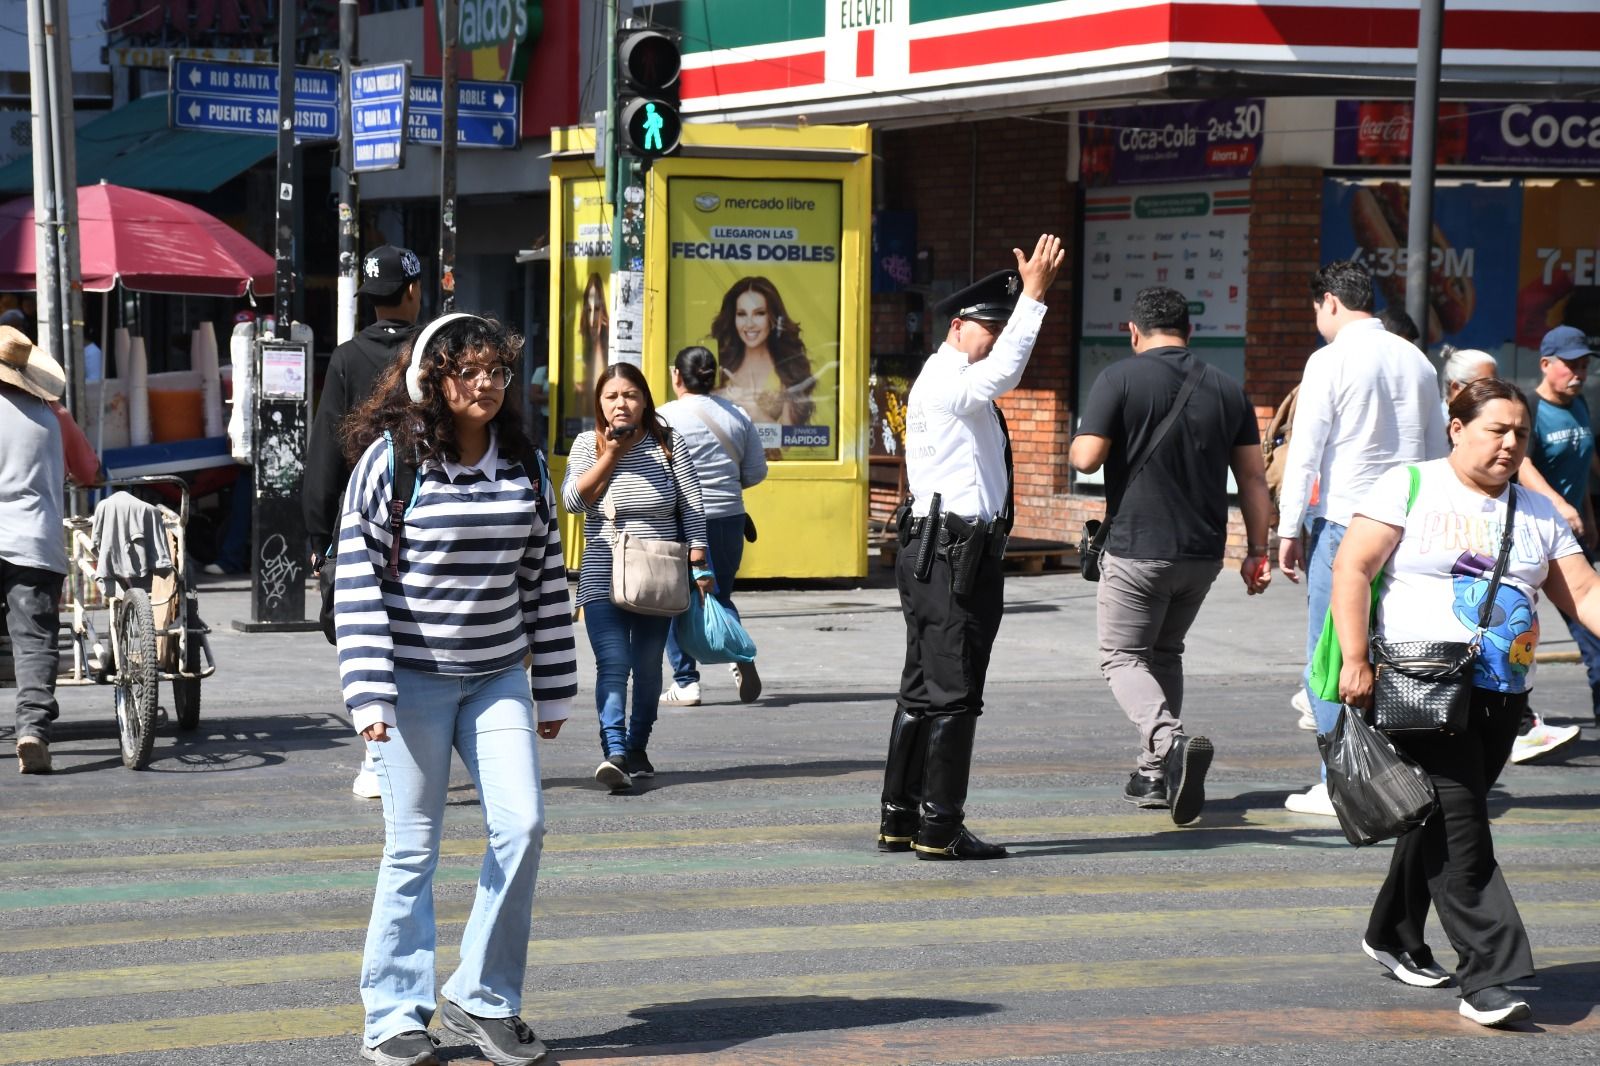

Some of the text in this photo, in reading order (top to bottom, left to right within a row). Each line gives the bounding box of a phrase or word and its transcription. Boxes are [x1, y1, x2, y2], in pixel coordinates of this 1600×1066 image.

[210, 71, 328, 95] RIO SANTA CARINA
[409, 88, 486, 106] SILICA ROBLE
[208, 104, 328, 128] PUENTE SAN UISITO
[408, 114, 428, 126] AZA
[409, 127, 438, 139] LEGIO
[1119, 123, 1196, 151] Coca-Cola
[724, 197, 815, 211] mercado libre
[714, 229, 794, 240] LLEGARON LAS
[595, 240, 612, 257] DOB
[671, 242, 836, 262] FECHAS DOBLES
